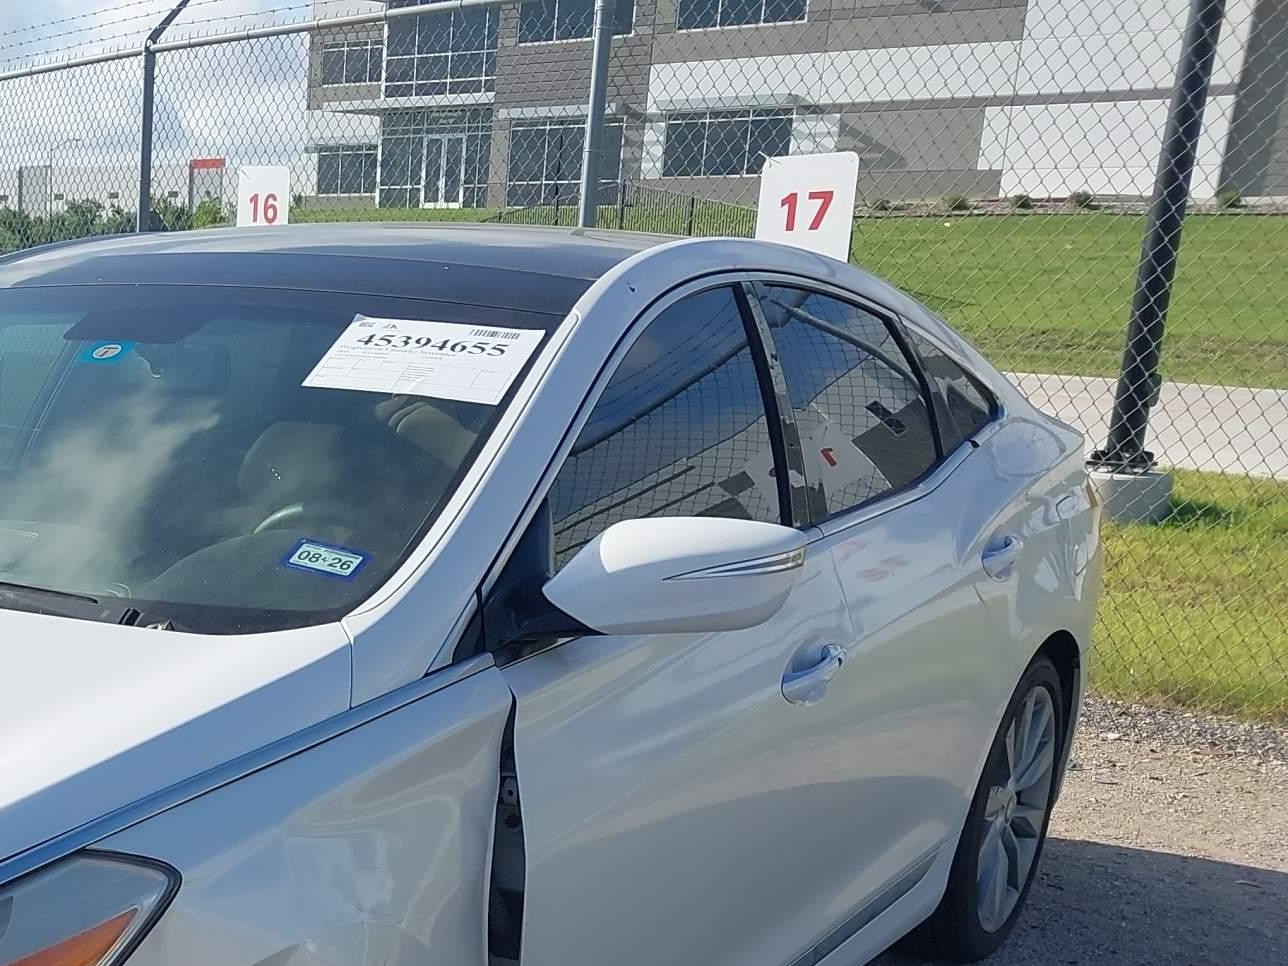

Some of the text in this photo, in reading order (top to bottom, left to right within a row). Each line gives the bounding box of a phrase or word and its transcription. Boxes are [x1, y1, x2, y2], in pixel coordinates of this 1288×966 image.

[249, 193, 278, 224] 16
[780, 190, 834, 231] 17
[356, 333, 510, 357] 45394655
[297, 550, 322, 563] 08
[327, 557, 353, 571] 26
